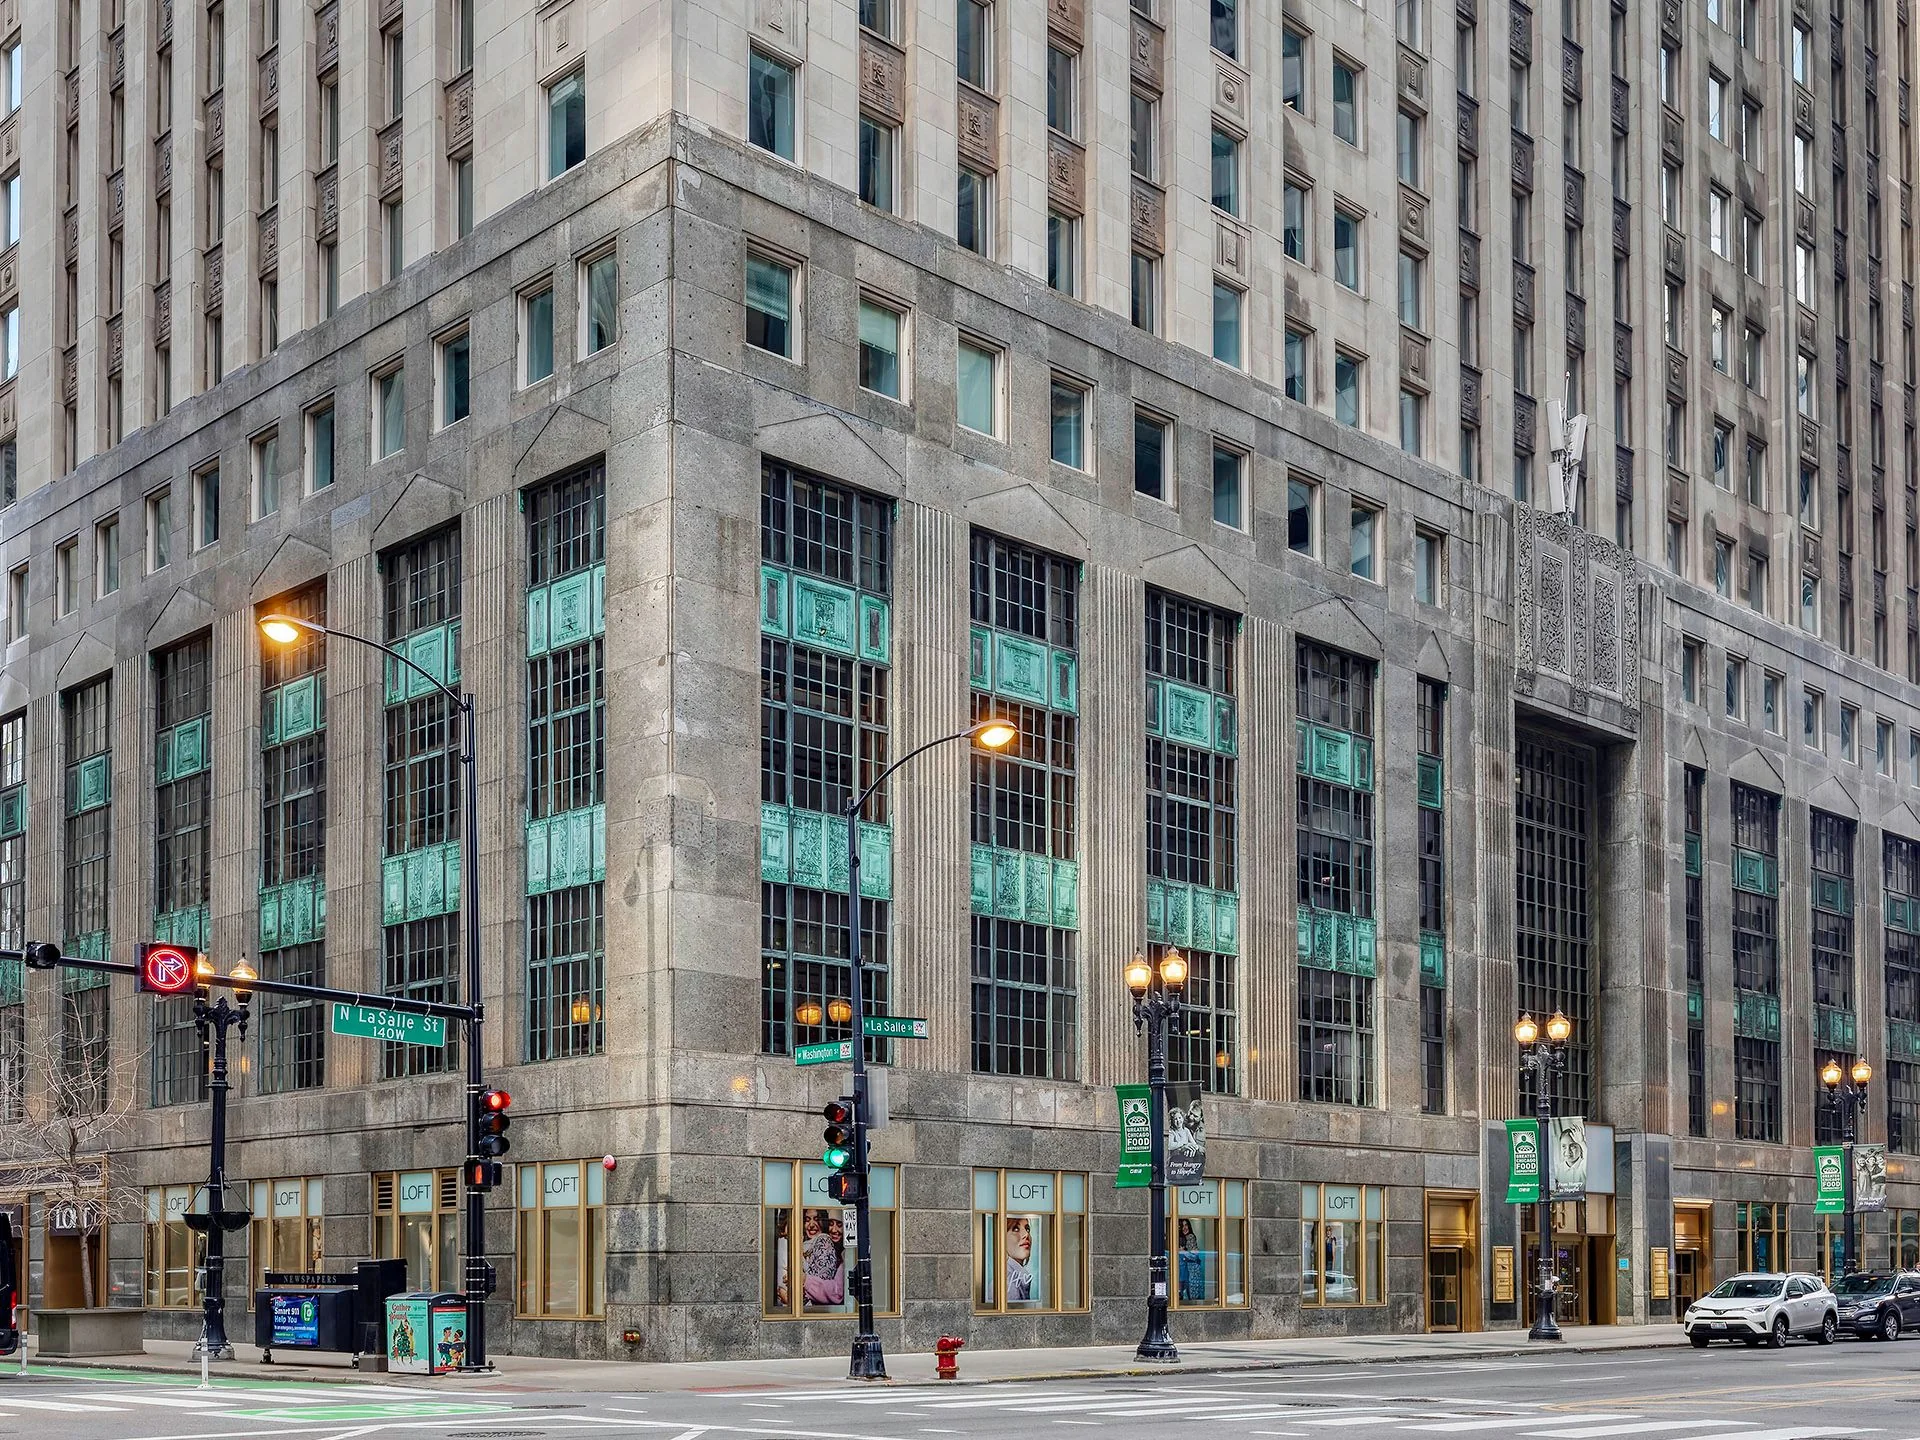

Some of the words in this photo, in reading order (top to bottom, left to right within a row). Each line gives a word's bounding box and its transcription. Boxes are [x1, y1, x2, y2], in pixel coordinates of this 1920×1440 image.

[340, 1005, 350, 1020] N
[359, 1008, 414, 1029] LaSalle
[423, 1017, 438, 1032] St
[373, 1026, 405, 1040] 140W
[871, 1020, 882, 1031] La
[884, 1020, 906, 1033] Salle
[802, 1047, 833, 1061] Washington
[1127, 1138, 1150, 1146] FOOD
[544, 1176, 578, 1194] LOFT
[810, 1177, 829, 1192] LO
[1011, 1184, 1048, 1199] LOFT
[275, 1191, 300, 1206] LOFT
[402, 1184, 431, 1200] LOFT
[1182, 1190, 1213, 1204] LOFT
[166, 1196, 187, 1211] LOFT
[1328, 1196, 1355, 1209] LOFT
[844, 1211, 856, 1220] ONE
[844, 1222, 856, 1231] WAY
[284, 1275, 337, 1283] NEWSPAPERS
[274, 1307, 290, 1315] Smart
[274, 1315, 286, 1324] Help
